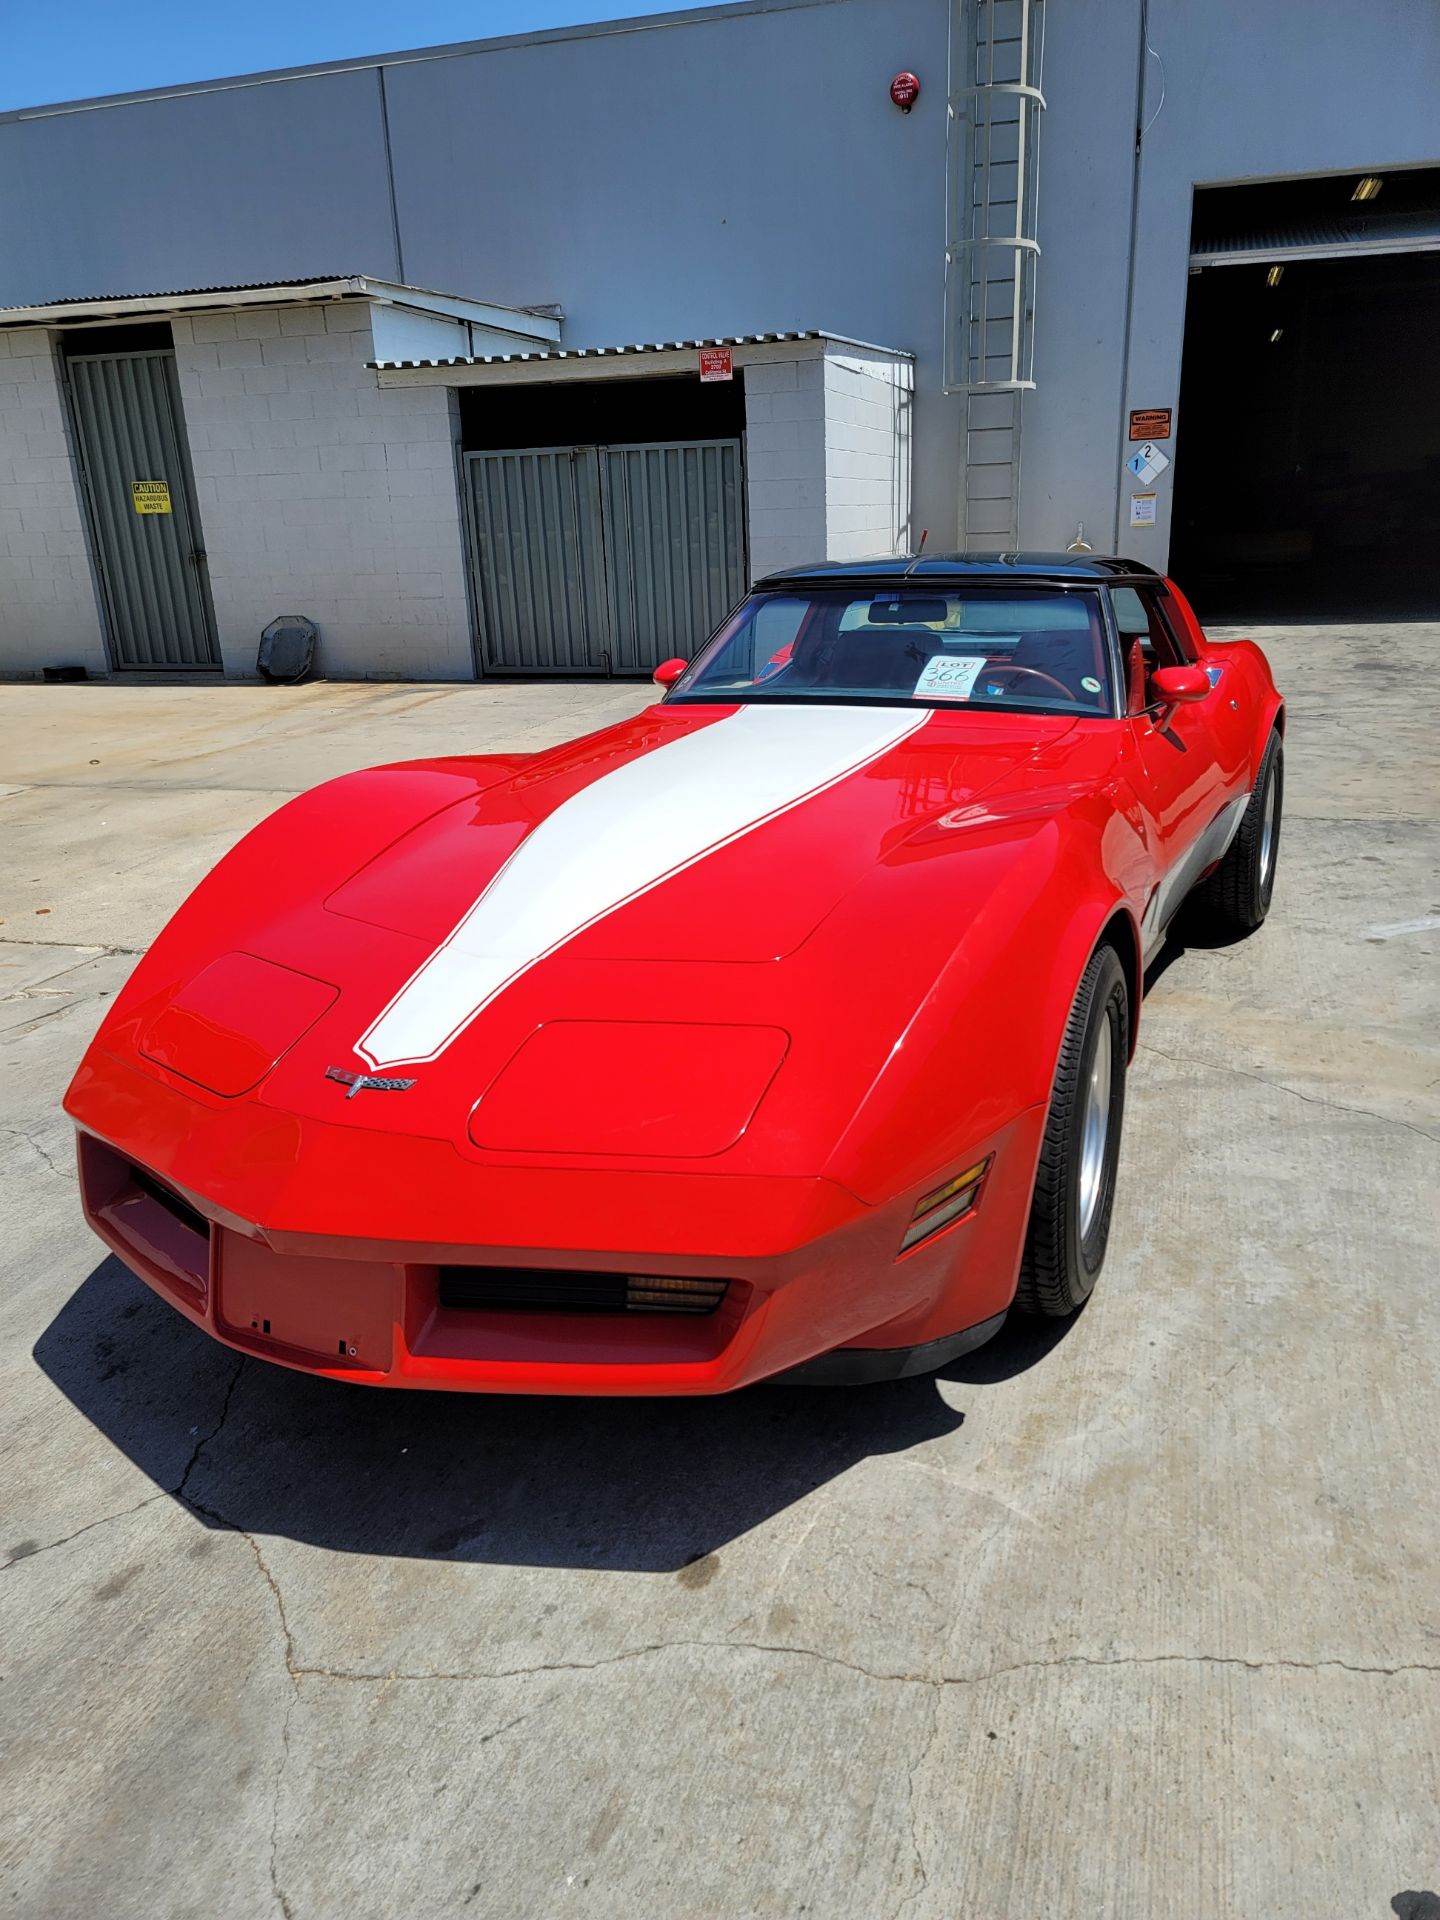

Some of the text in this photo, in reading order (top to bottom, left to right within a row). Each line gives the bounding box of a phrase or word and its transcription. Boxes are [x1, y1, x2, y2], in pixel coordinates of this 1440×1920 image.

[701, 351, 730, 360] CONTROL VALVE
[1135, 414, 1167, 422] WARNING
[1144, 445, 1152, 458] 2
[1134, 458, 1139, 471] 1
[134, 483, 167, 493] CAUTION
[135, 494, 169, 502] HAZARDOUS
[143, 502, 164, 510] WASTE
[923, 667, 970, 681] 366
